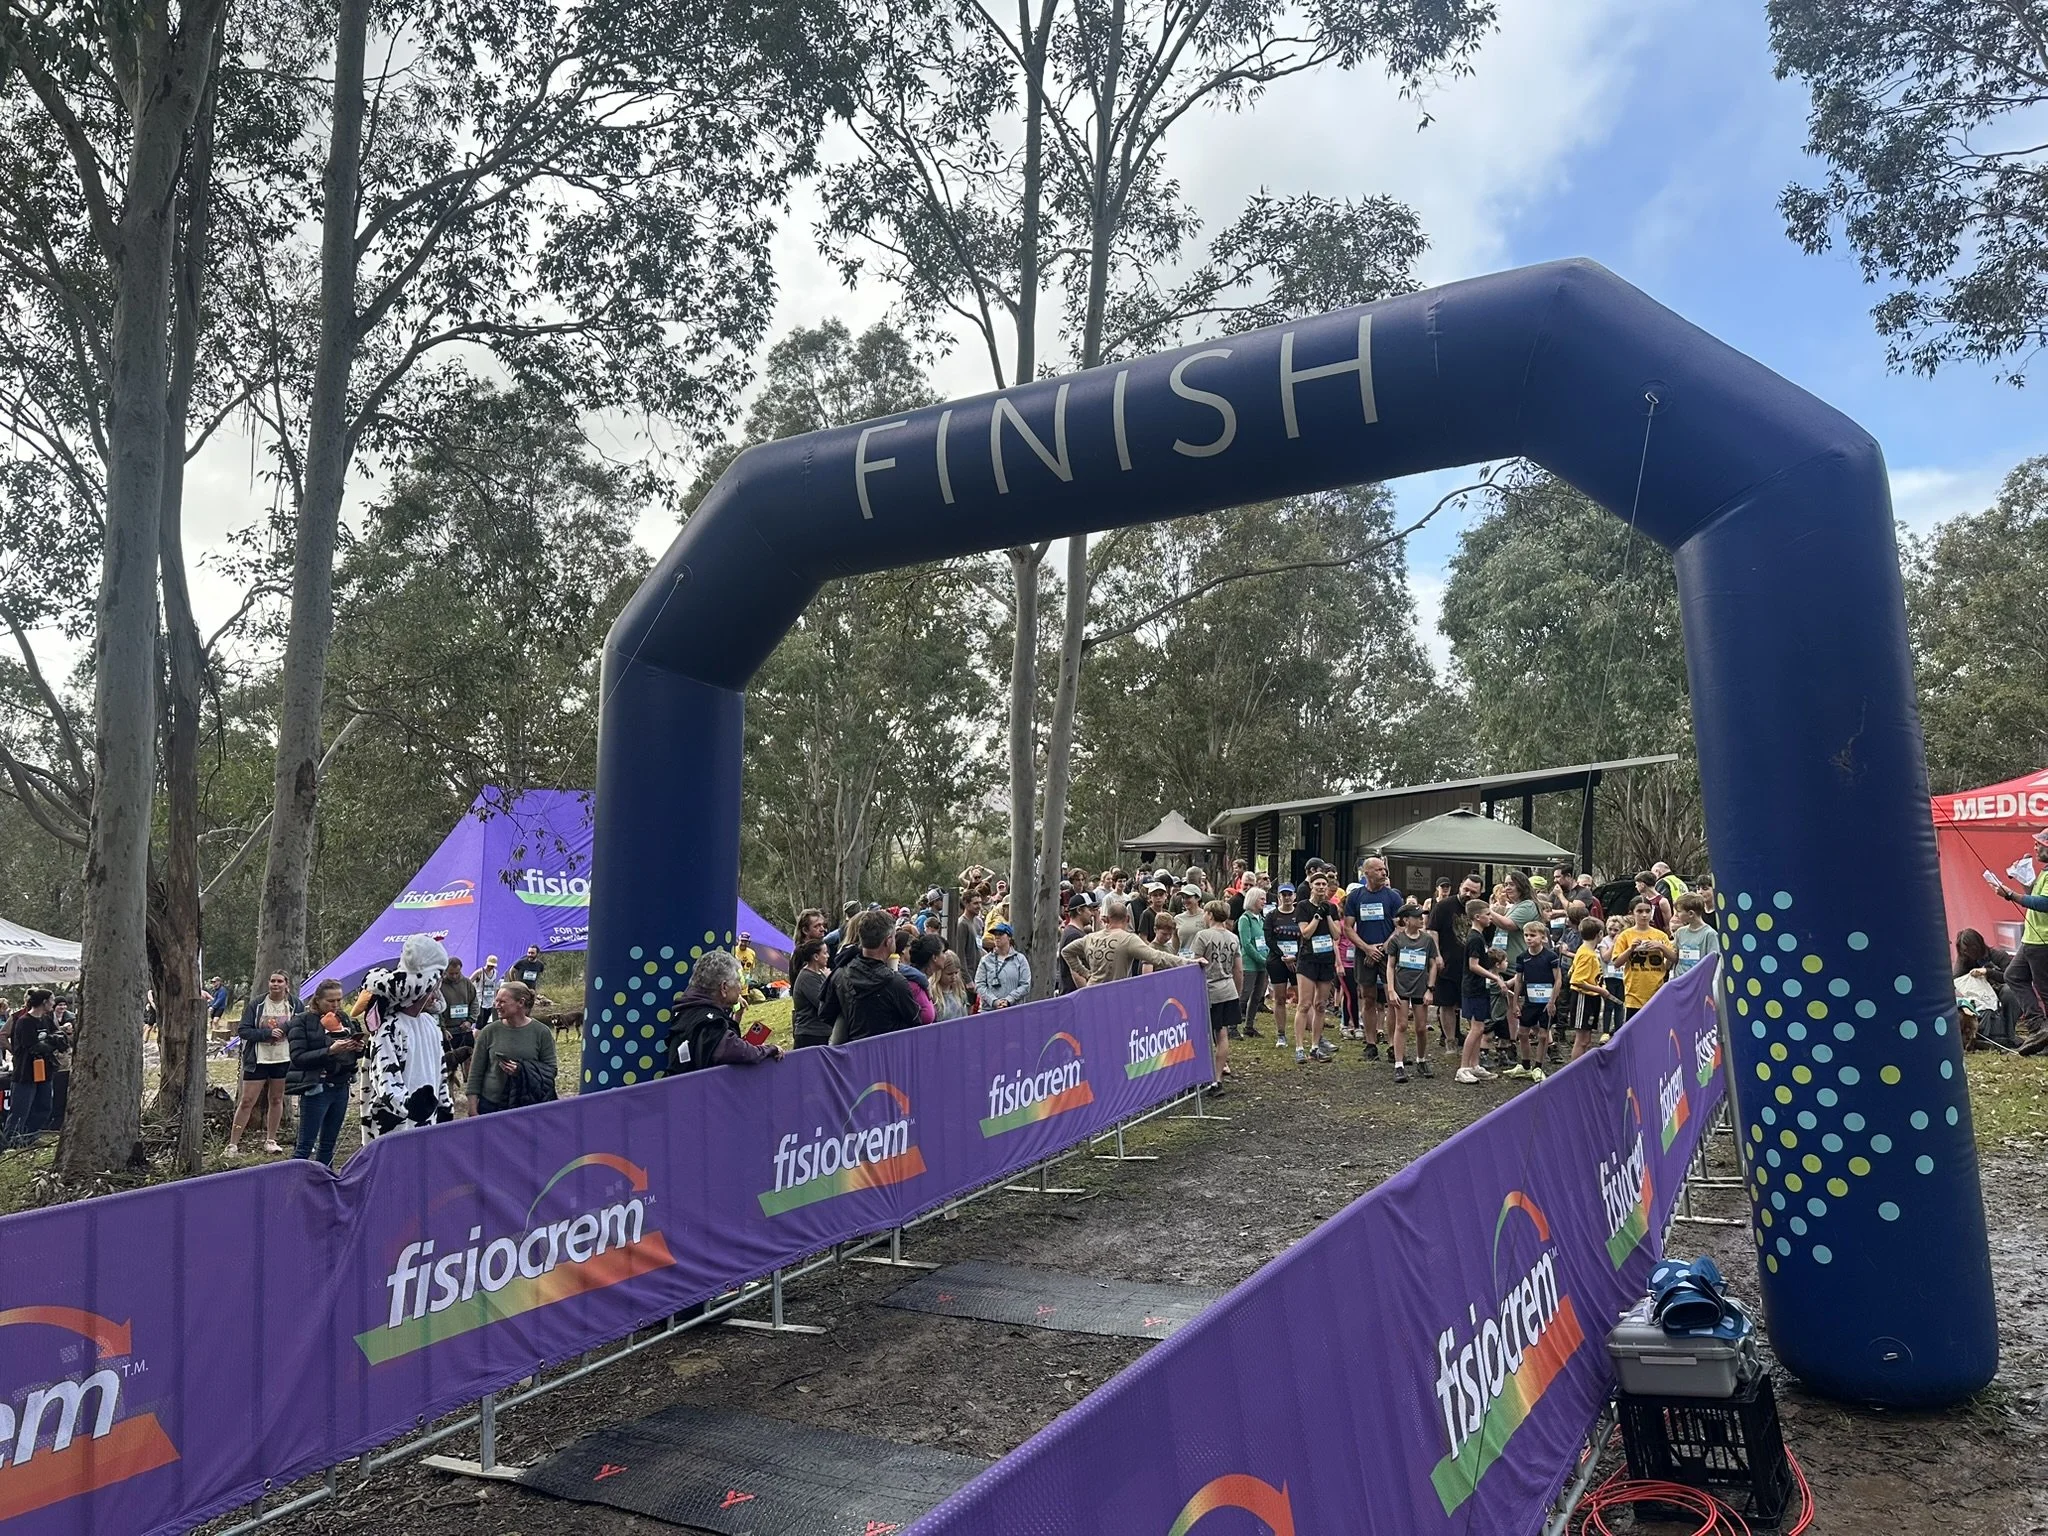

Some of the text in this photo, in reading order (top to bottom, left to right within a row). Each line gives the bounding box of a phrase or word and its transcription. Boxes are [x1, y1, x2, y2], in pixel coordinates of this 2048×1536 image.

[855, 315, 1378, 519] FINISH
[1953, 791, 2048, 821] MEDIC
[401, 888, 470, 904] fisiocrem
[523, 868, 591, 896] fisio
[1088, 949, 1116, 962] ROC
[1090, 938, 1118, 950] MAC
[1212, 941, 1235, 952] MAC
[1129, 1022, 1187, 1064] fisiocrem
[989, 1059, 1081, 1119] fisiocrem
[774, 1119, 908, 1193] fisiocrem
[386, 1199, 644, 1329] fisiocrem
[1436, 1251, 1560, 1461] fisiocrem
